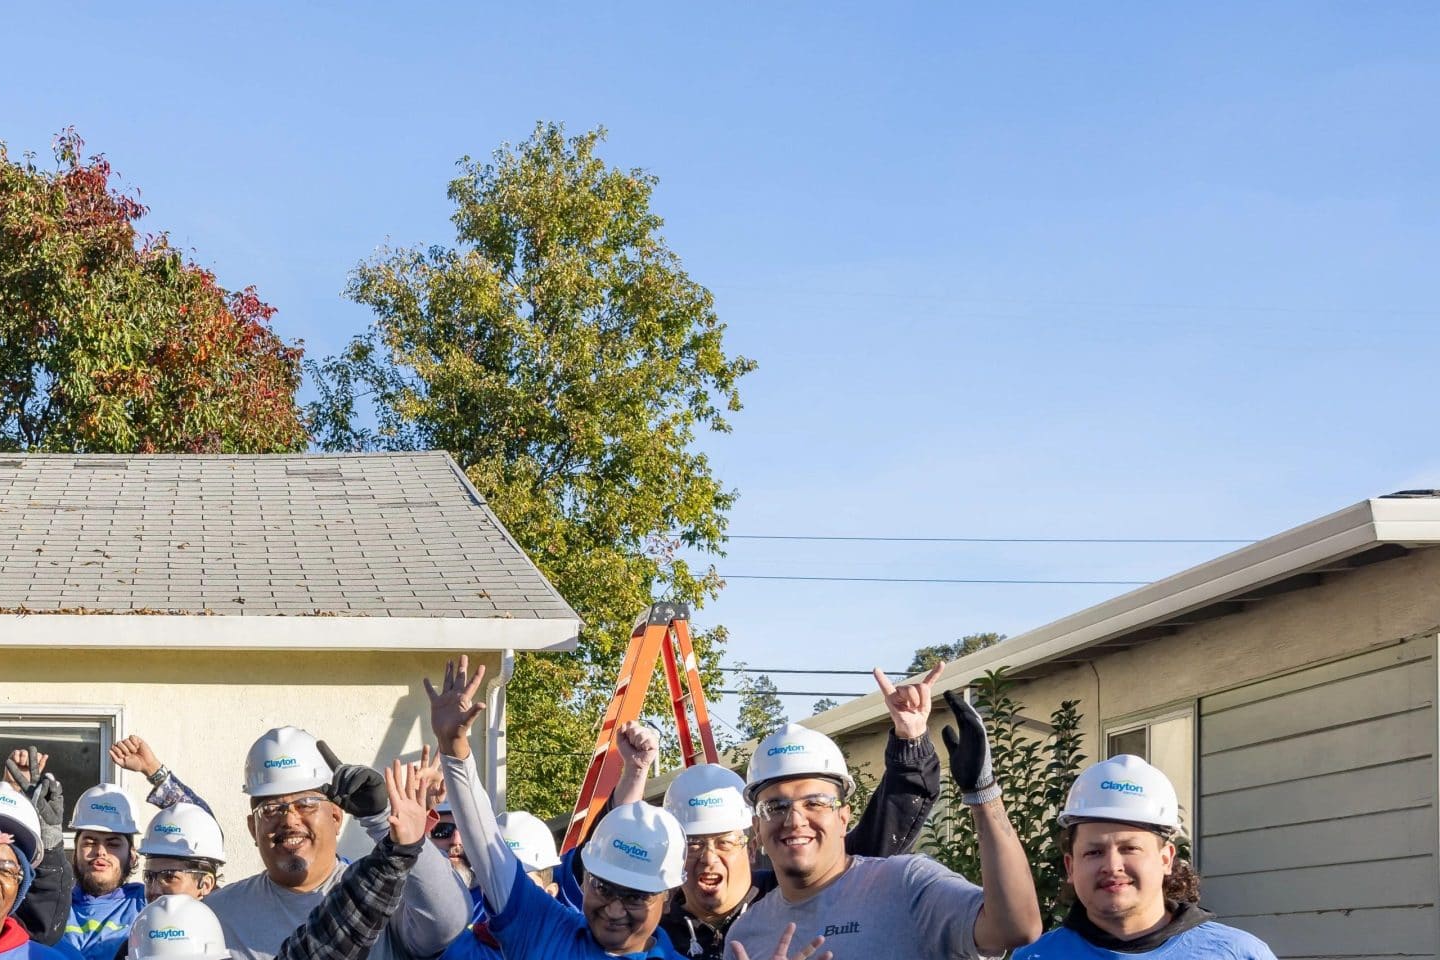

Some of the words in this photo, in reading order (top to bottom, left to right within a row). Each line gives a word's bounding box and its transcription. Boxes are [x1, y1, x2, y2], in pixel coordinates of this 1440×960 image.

[767, 744, 804, 757] Clayton
[264, 758, 296, 769] Clayton
[1101, 780, 1143, 792] Clayton
[91, 803, 117, 812] Clayton
[688, 797, 723, 807] Clayton
[154, 824, 181, 834] Clayton
[613, 839, 648, 858] Clayton
[149, 929, 184, 939] Clayton
[824, 921, 860, 937] Built
